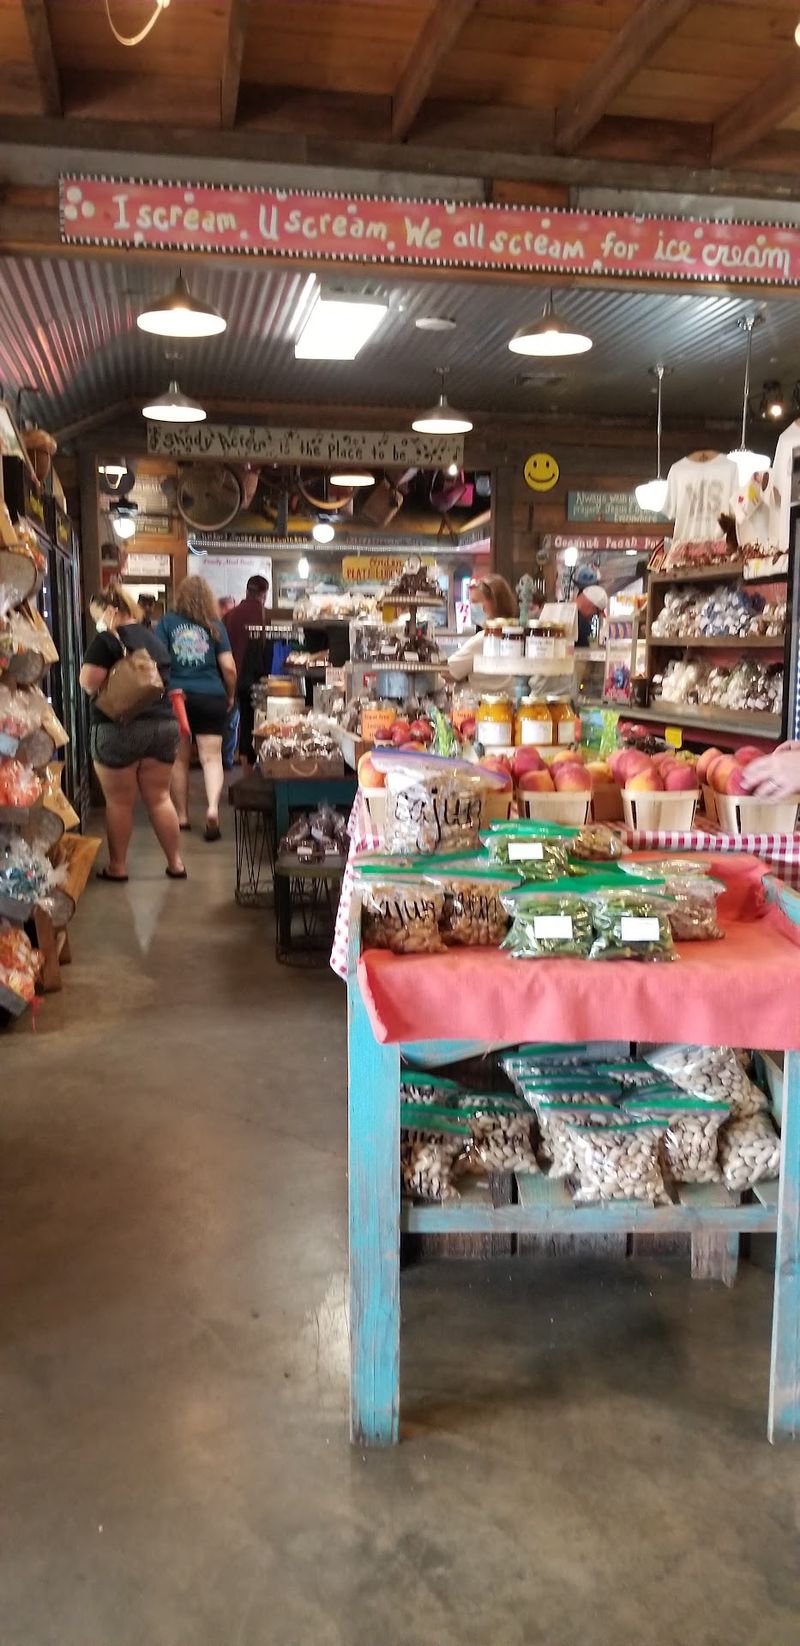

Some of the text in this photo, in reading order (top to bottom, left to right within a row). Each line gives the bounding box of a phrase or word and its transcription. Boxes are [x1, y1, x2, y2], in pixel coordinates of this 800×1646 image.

[112, 193, 130, 230] I
[258, 204, 279, 241] U
[404, 216, 442, 249] We
[453, 222, 484, 249] all
[489, 230, 585, 261] scream
[601, 231, 639, 260] for
[655, 229, 697, 265] ice
[702, 243, 791, 279] cream
[300, 440, 320, 458] the
[372, 445, 385, 460] to
